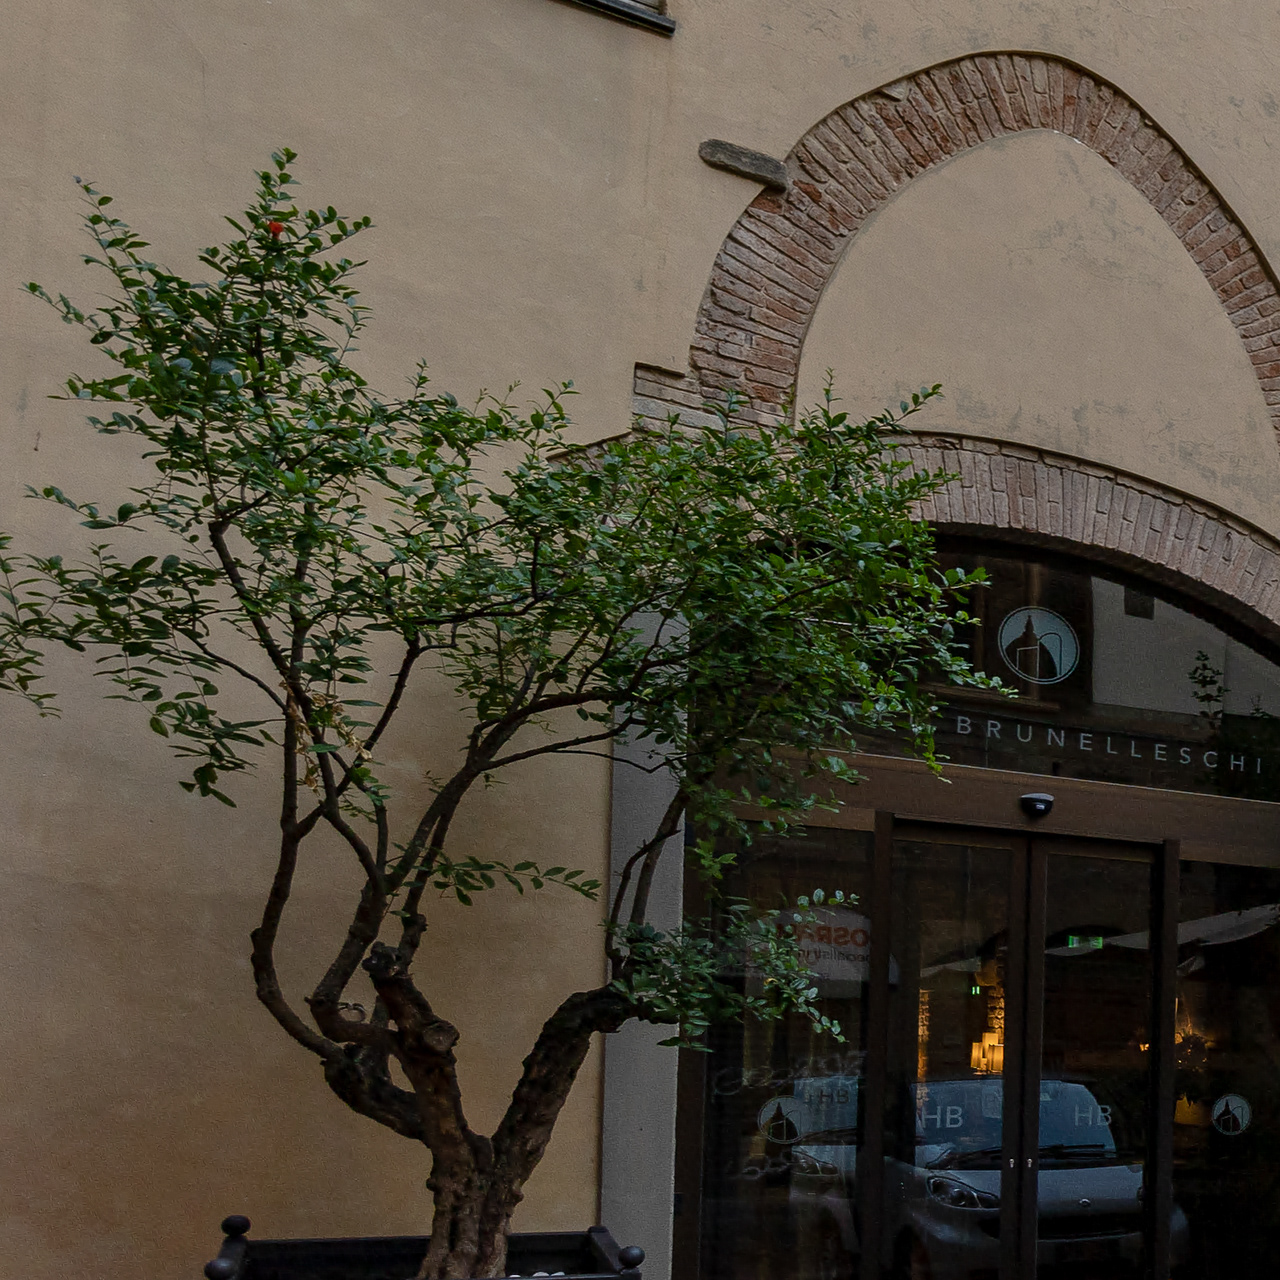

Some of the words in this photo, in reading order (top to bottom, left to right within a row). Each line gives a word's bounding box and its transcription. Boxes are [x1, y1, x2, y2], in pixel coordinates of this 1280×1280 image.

[957, 715, 1262, 774] BRUNELLESCHI
[921, 1105, 964, 1129] HB
[1074, 1104, 1113, 1127] HB
